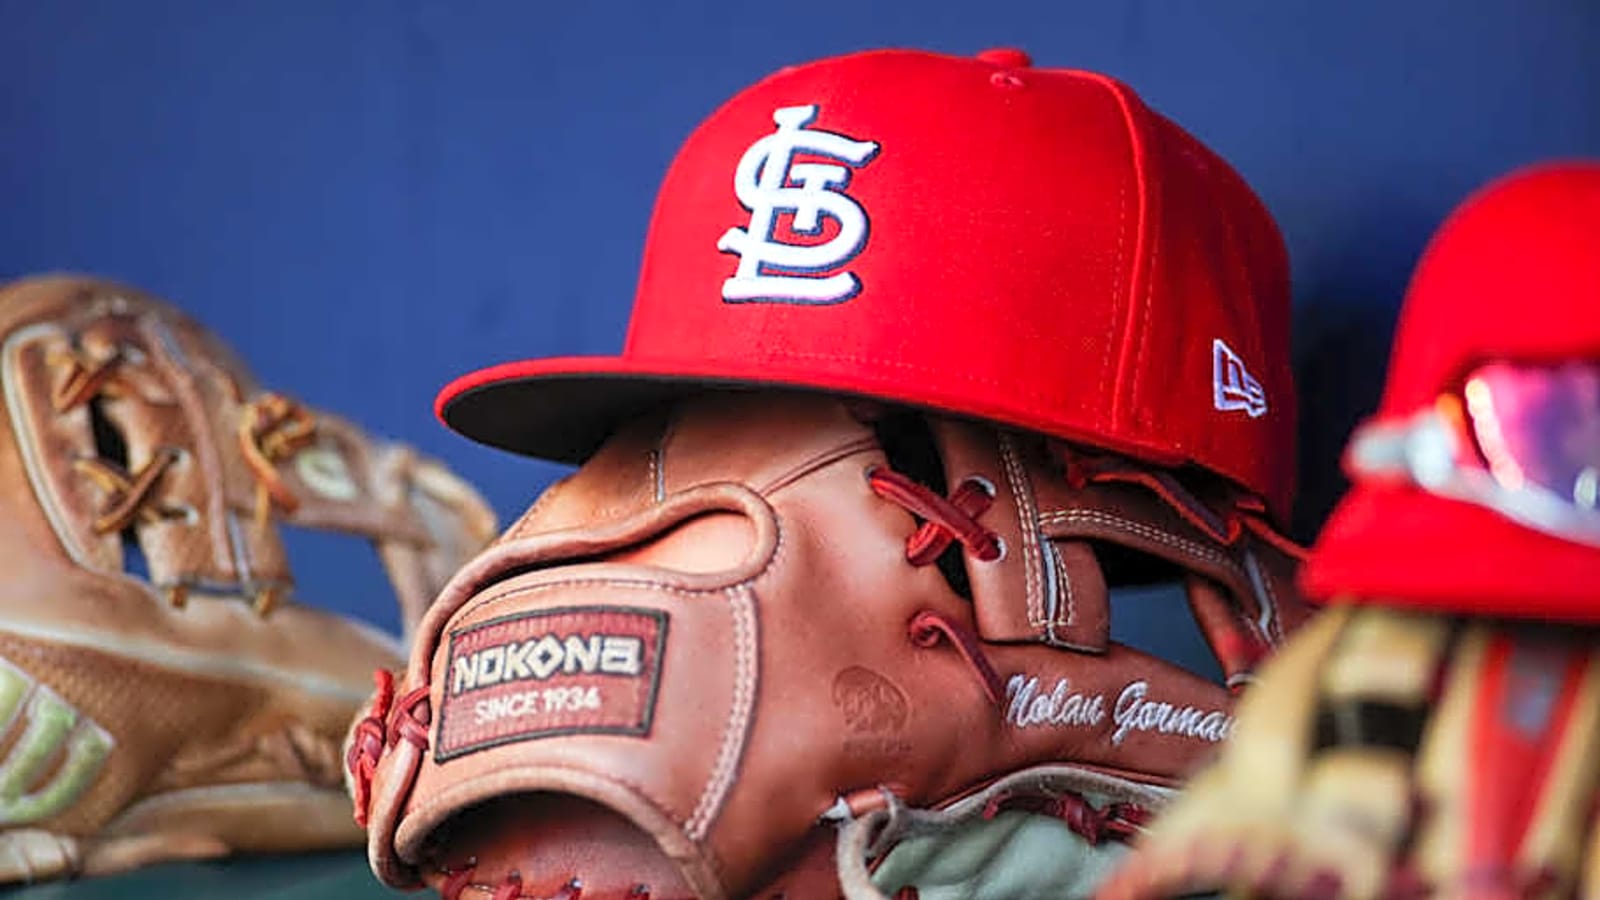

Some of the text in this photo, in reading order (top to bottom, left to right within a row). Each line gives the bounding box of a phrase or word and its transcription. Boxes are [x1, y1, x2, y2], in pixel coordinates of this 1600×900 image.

[474, 686, 601, 724] SINCE 1934
[1005, 674, 1105, 727] Nolan
